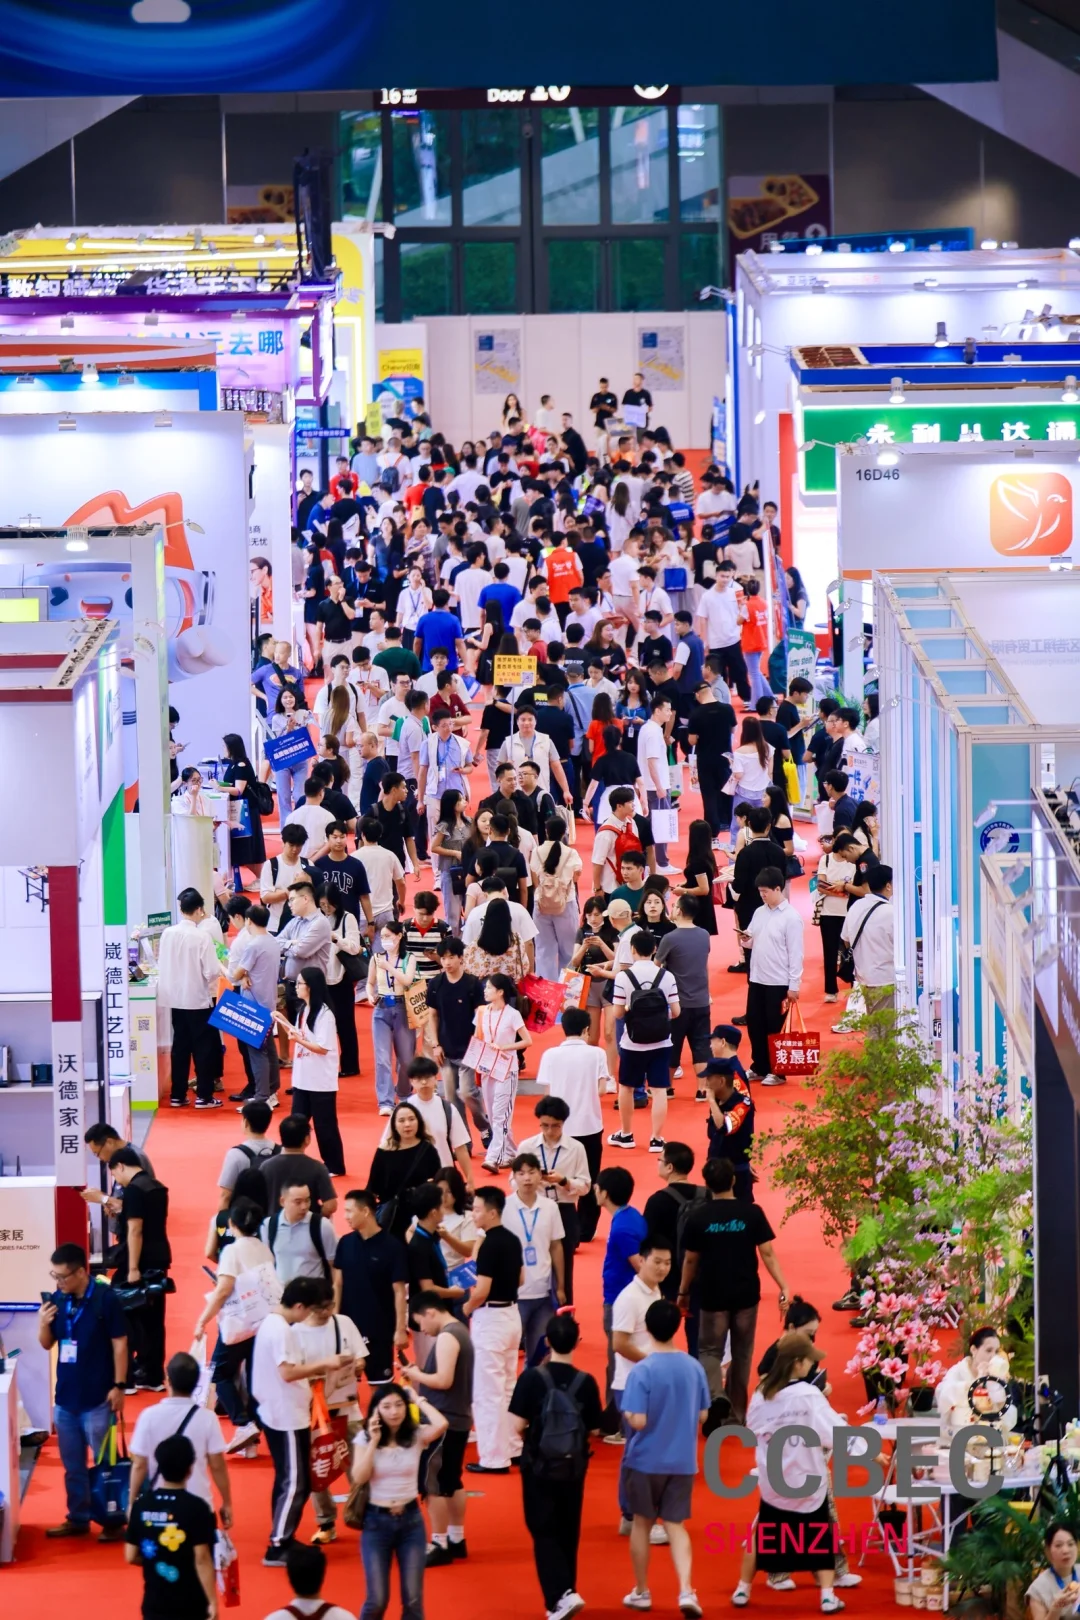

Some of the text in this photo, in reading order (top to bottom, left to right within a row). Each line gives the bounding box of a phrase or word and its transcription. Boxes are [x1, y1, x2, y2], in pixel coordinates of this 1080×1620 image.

[380, 89, 400, 104] 16
[487, 88, 525, 103] Door
[856, 469, 900, 481] 16D46
[775, 1048, 820, 1065] 我最红
[58, 1053, 80, 1155] 沃德家居
